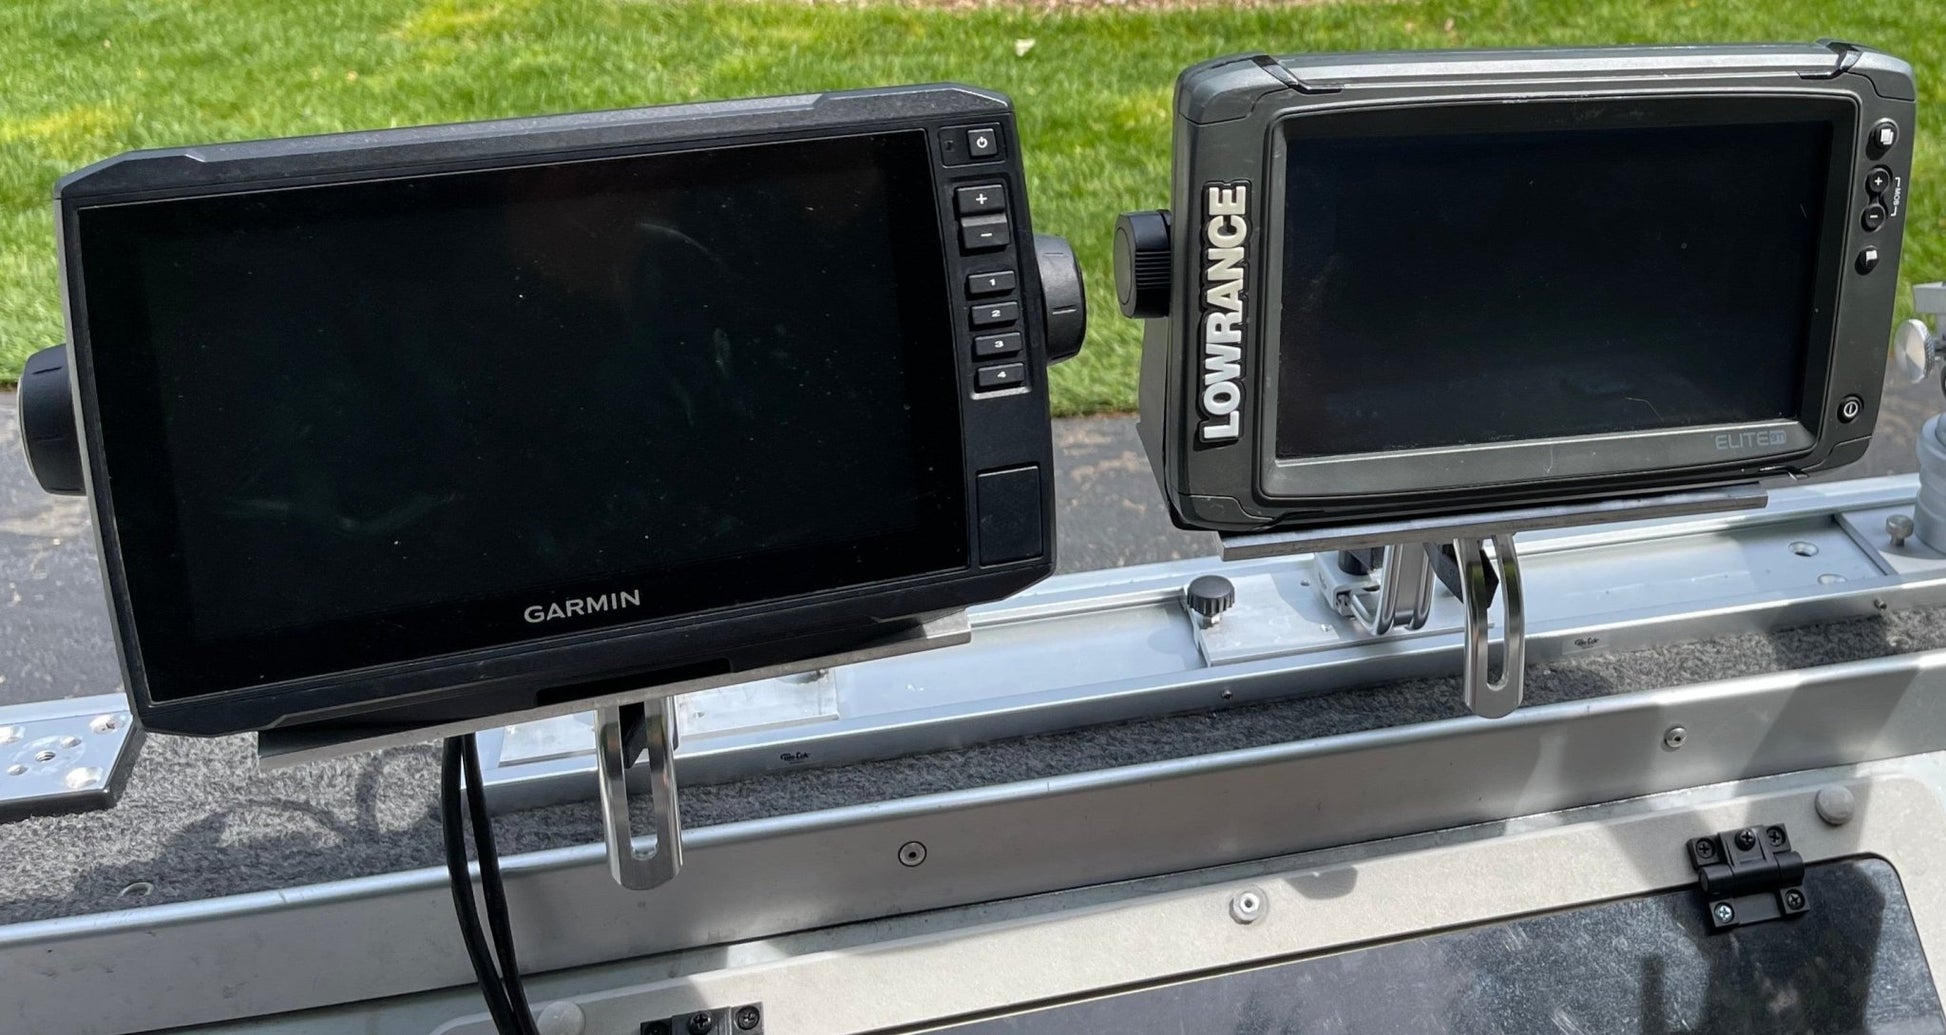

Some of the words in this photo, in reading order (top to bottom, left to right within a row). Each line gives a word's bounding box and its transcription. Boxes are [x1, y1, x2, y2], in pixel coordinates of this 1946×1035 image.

[989, 278, 997, 287] 1
[991, 310, 1001, 318] 2
[1203, 186, 1248, 439] LOWRANCE
[994, 340, 1004, 349] 3
[997, 371, 1007, 379] 4
[1715, 431, 1769, 450] ELITE
[524, 589, 640, 623] GARMIN
